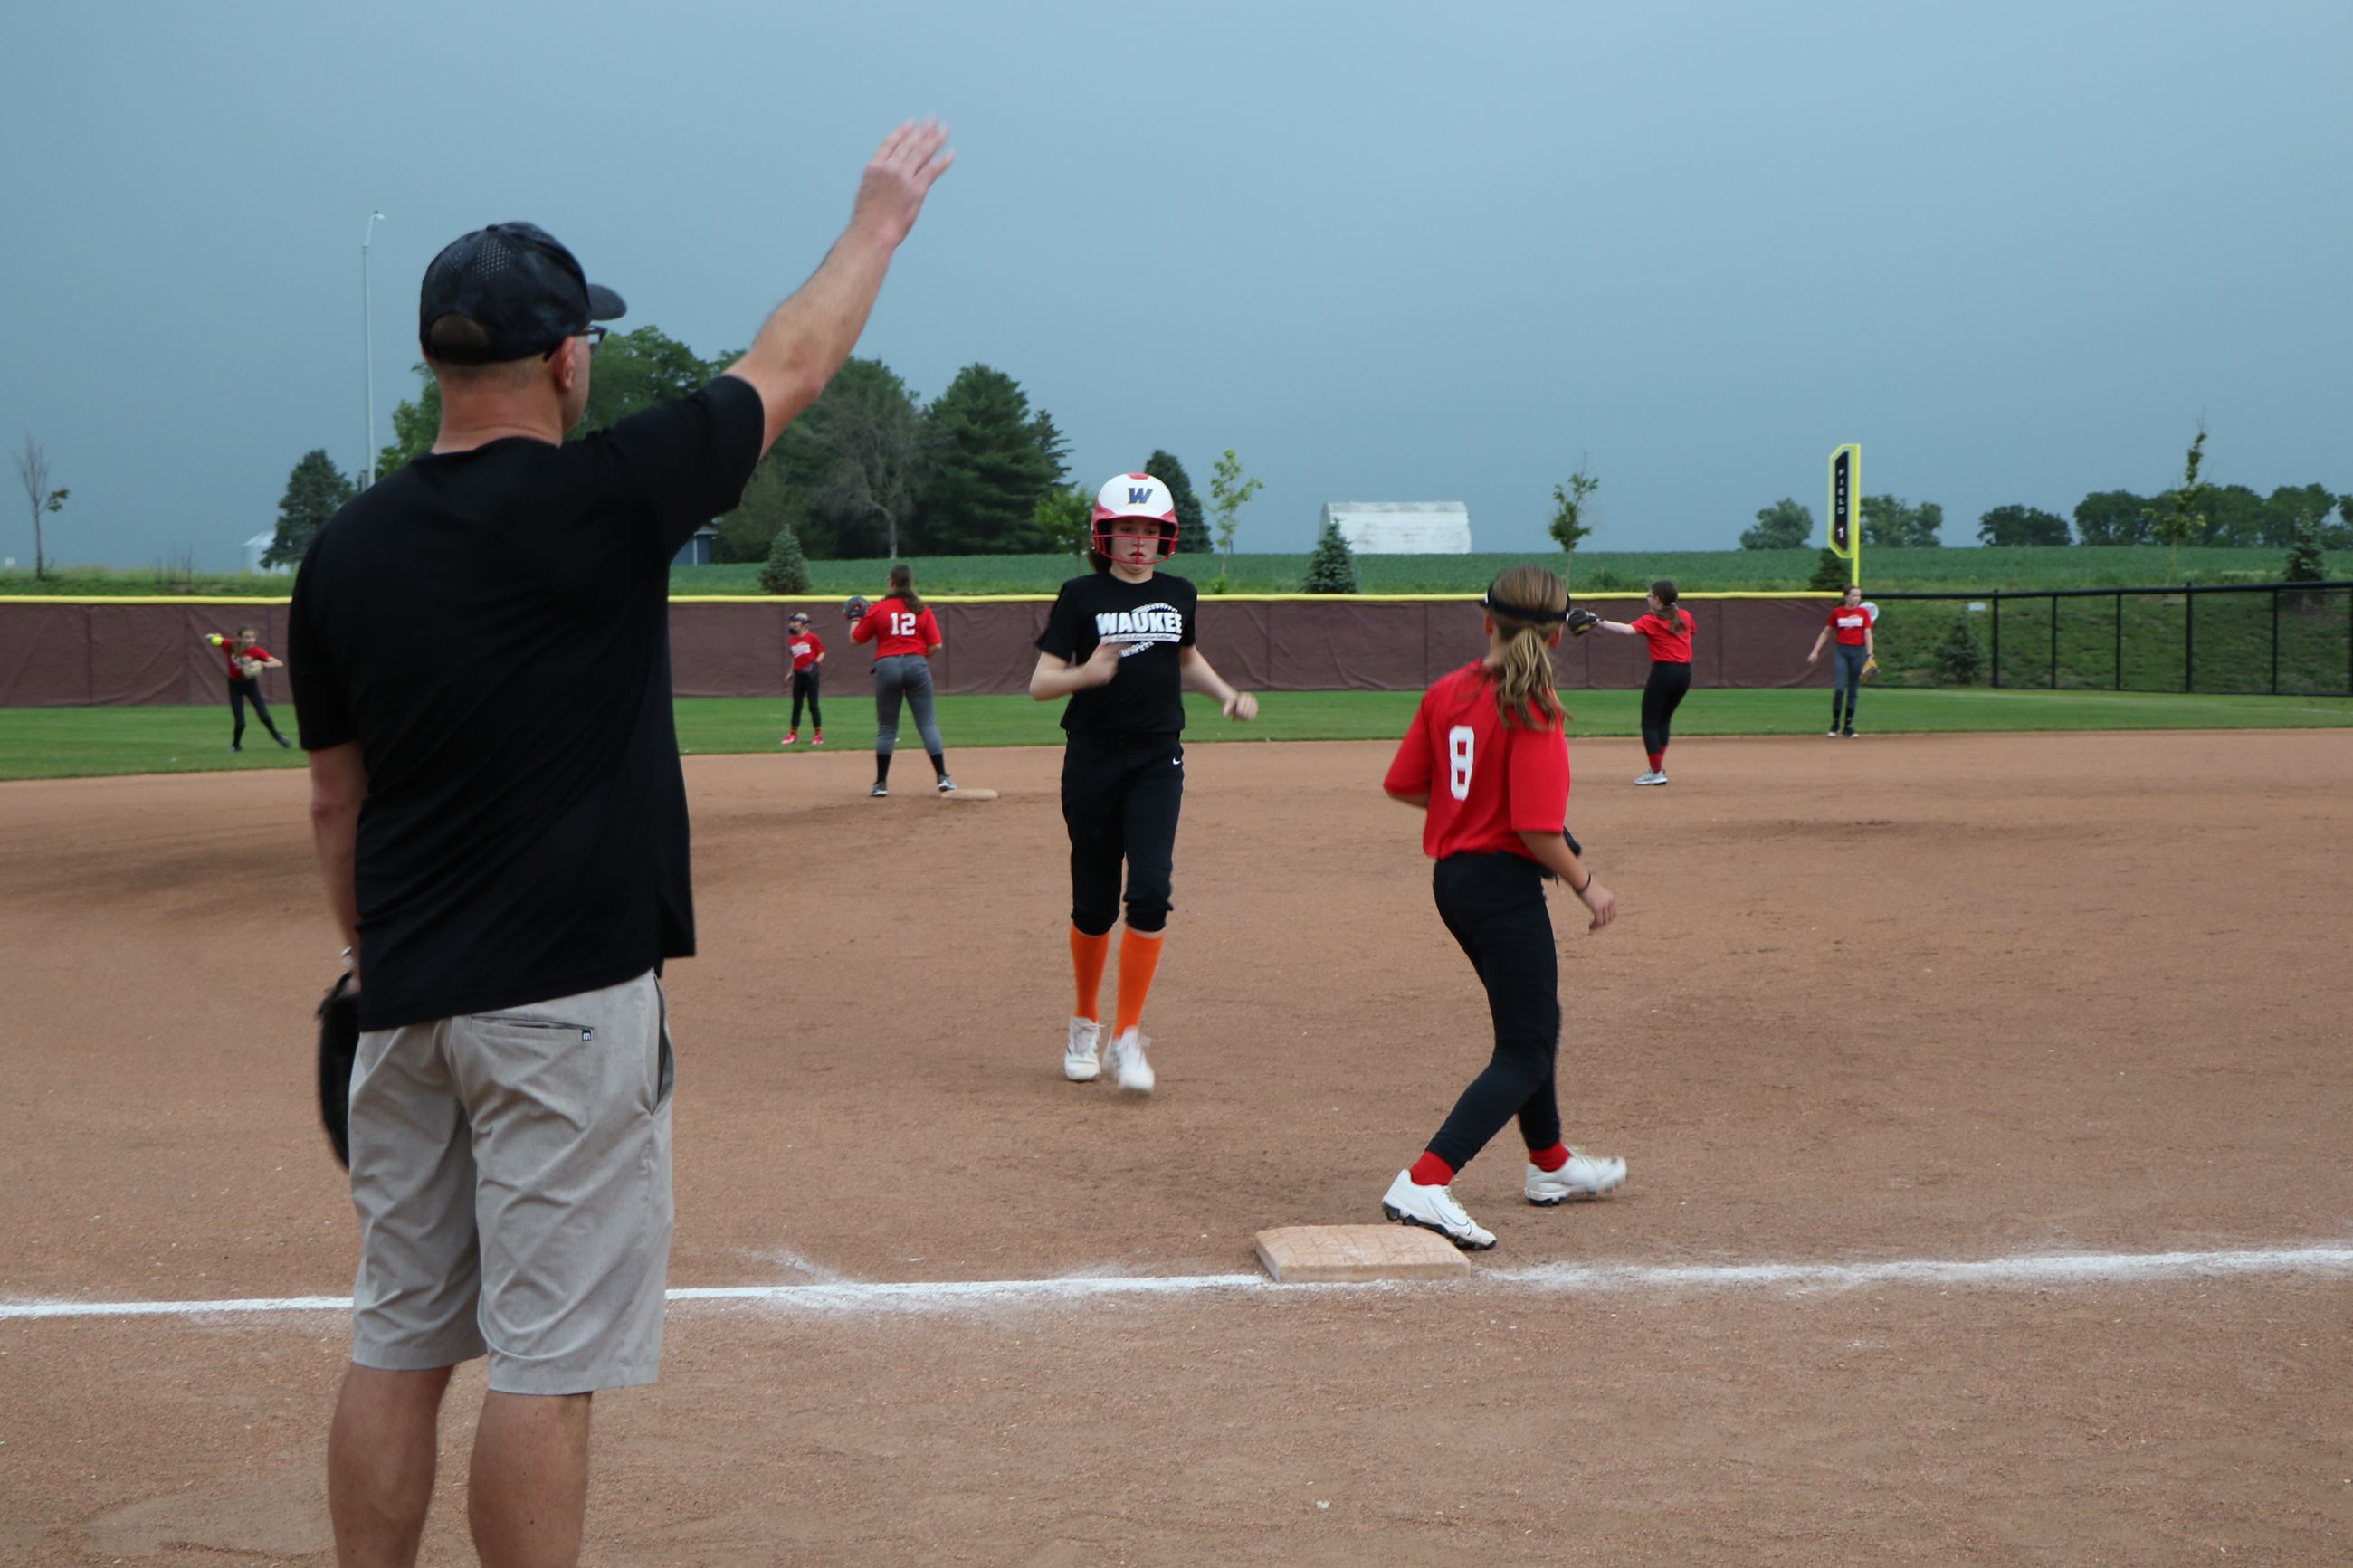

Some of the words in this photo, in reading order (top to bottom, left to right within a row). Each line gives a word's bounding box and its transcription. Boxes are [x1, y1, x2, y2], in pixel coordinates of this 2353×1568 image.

[1127, 487, 1154, 505] W
[1837, 468, 1846, 515] FIELD
[1837, 527, 1844, 539] 1
[890, 612, 917, 636] 12
[1449, 725, 1475, 801] 8
